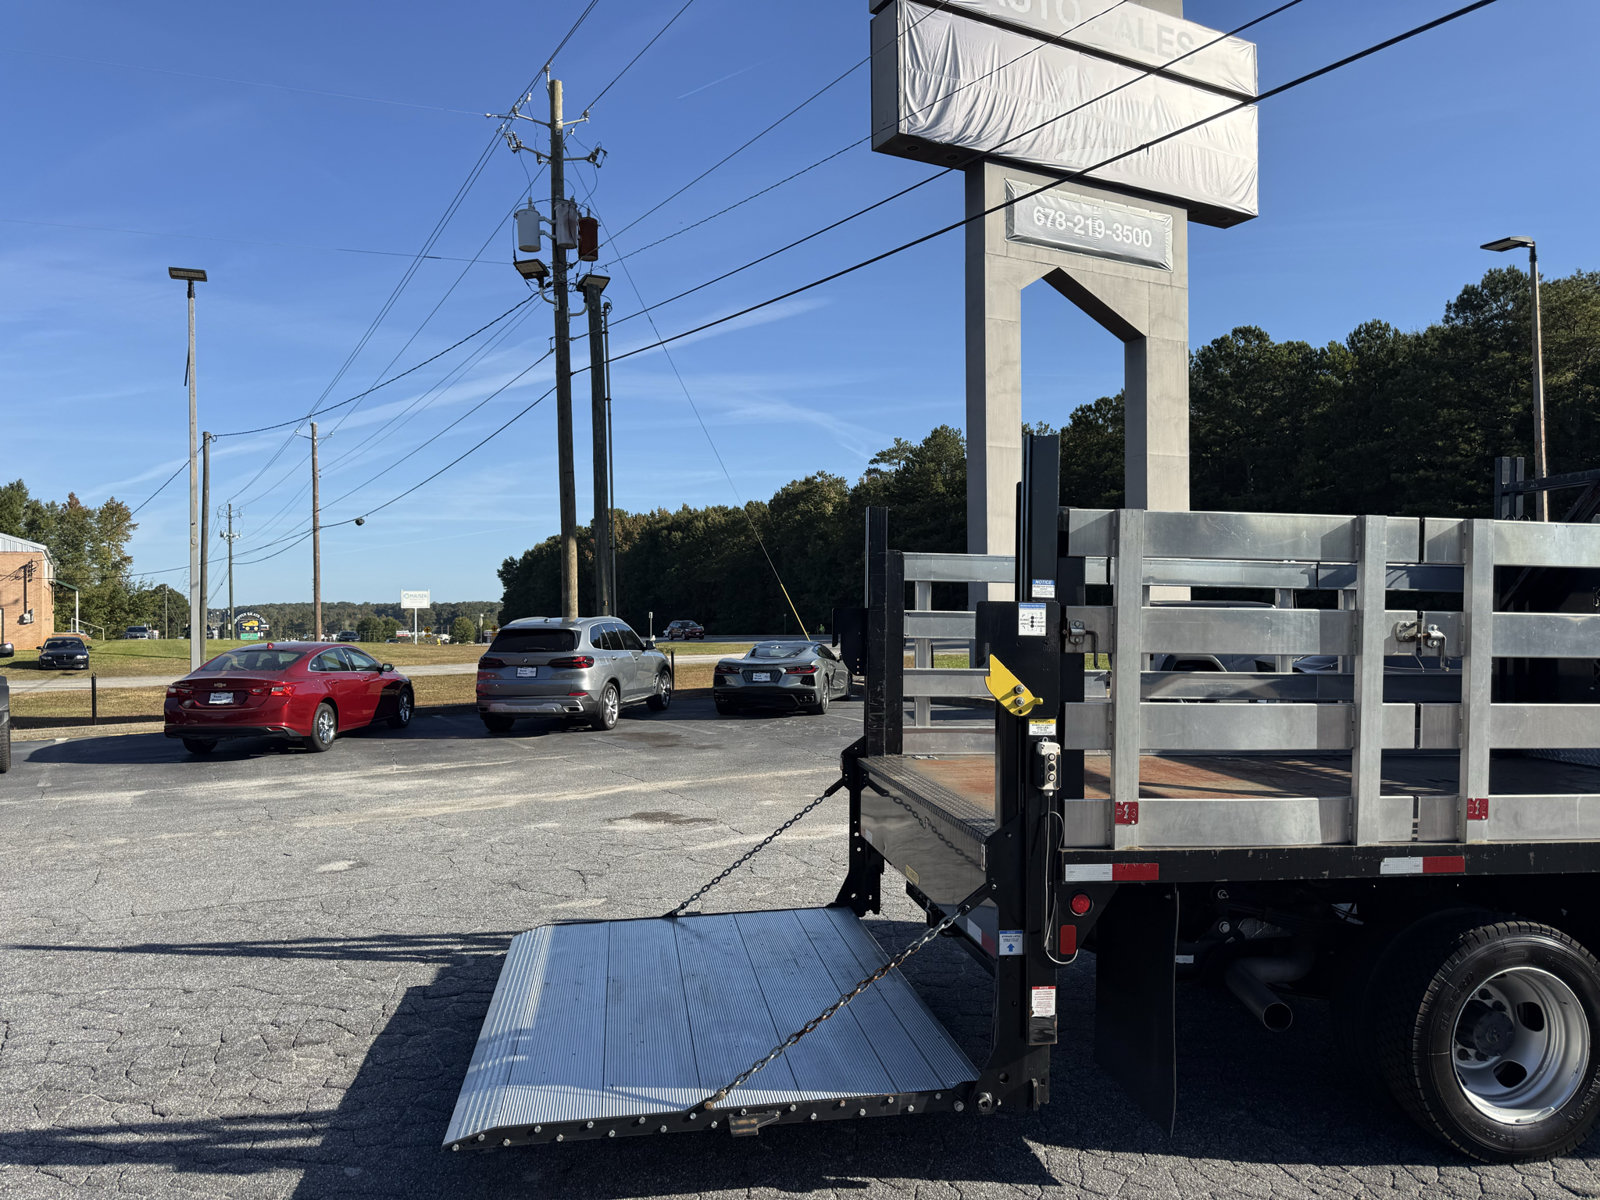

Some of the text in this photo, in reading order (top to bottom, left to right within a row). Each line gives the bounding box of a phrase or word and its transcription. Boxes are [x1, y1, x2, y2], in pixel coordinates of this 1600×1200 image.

[997, 0, 1195, 66] TO ALES
[1033, 206, 1152, 248] 678-219-3500
